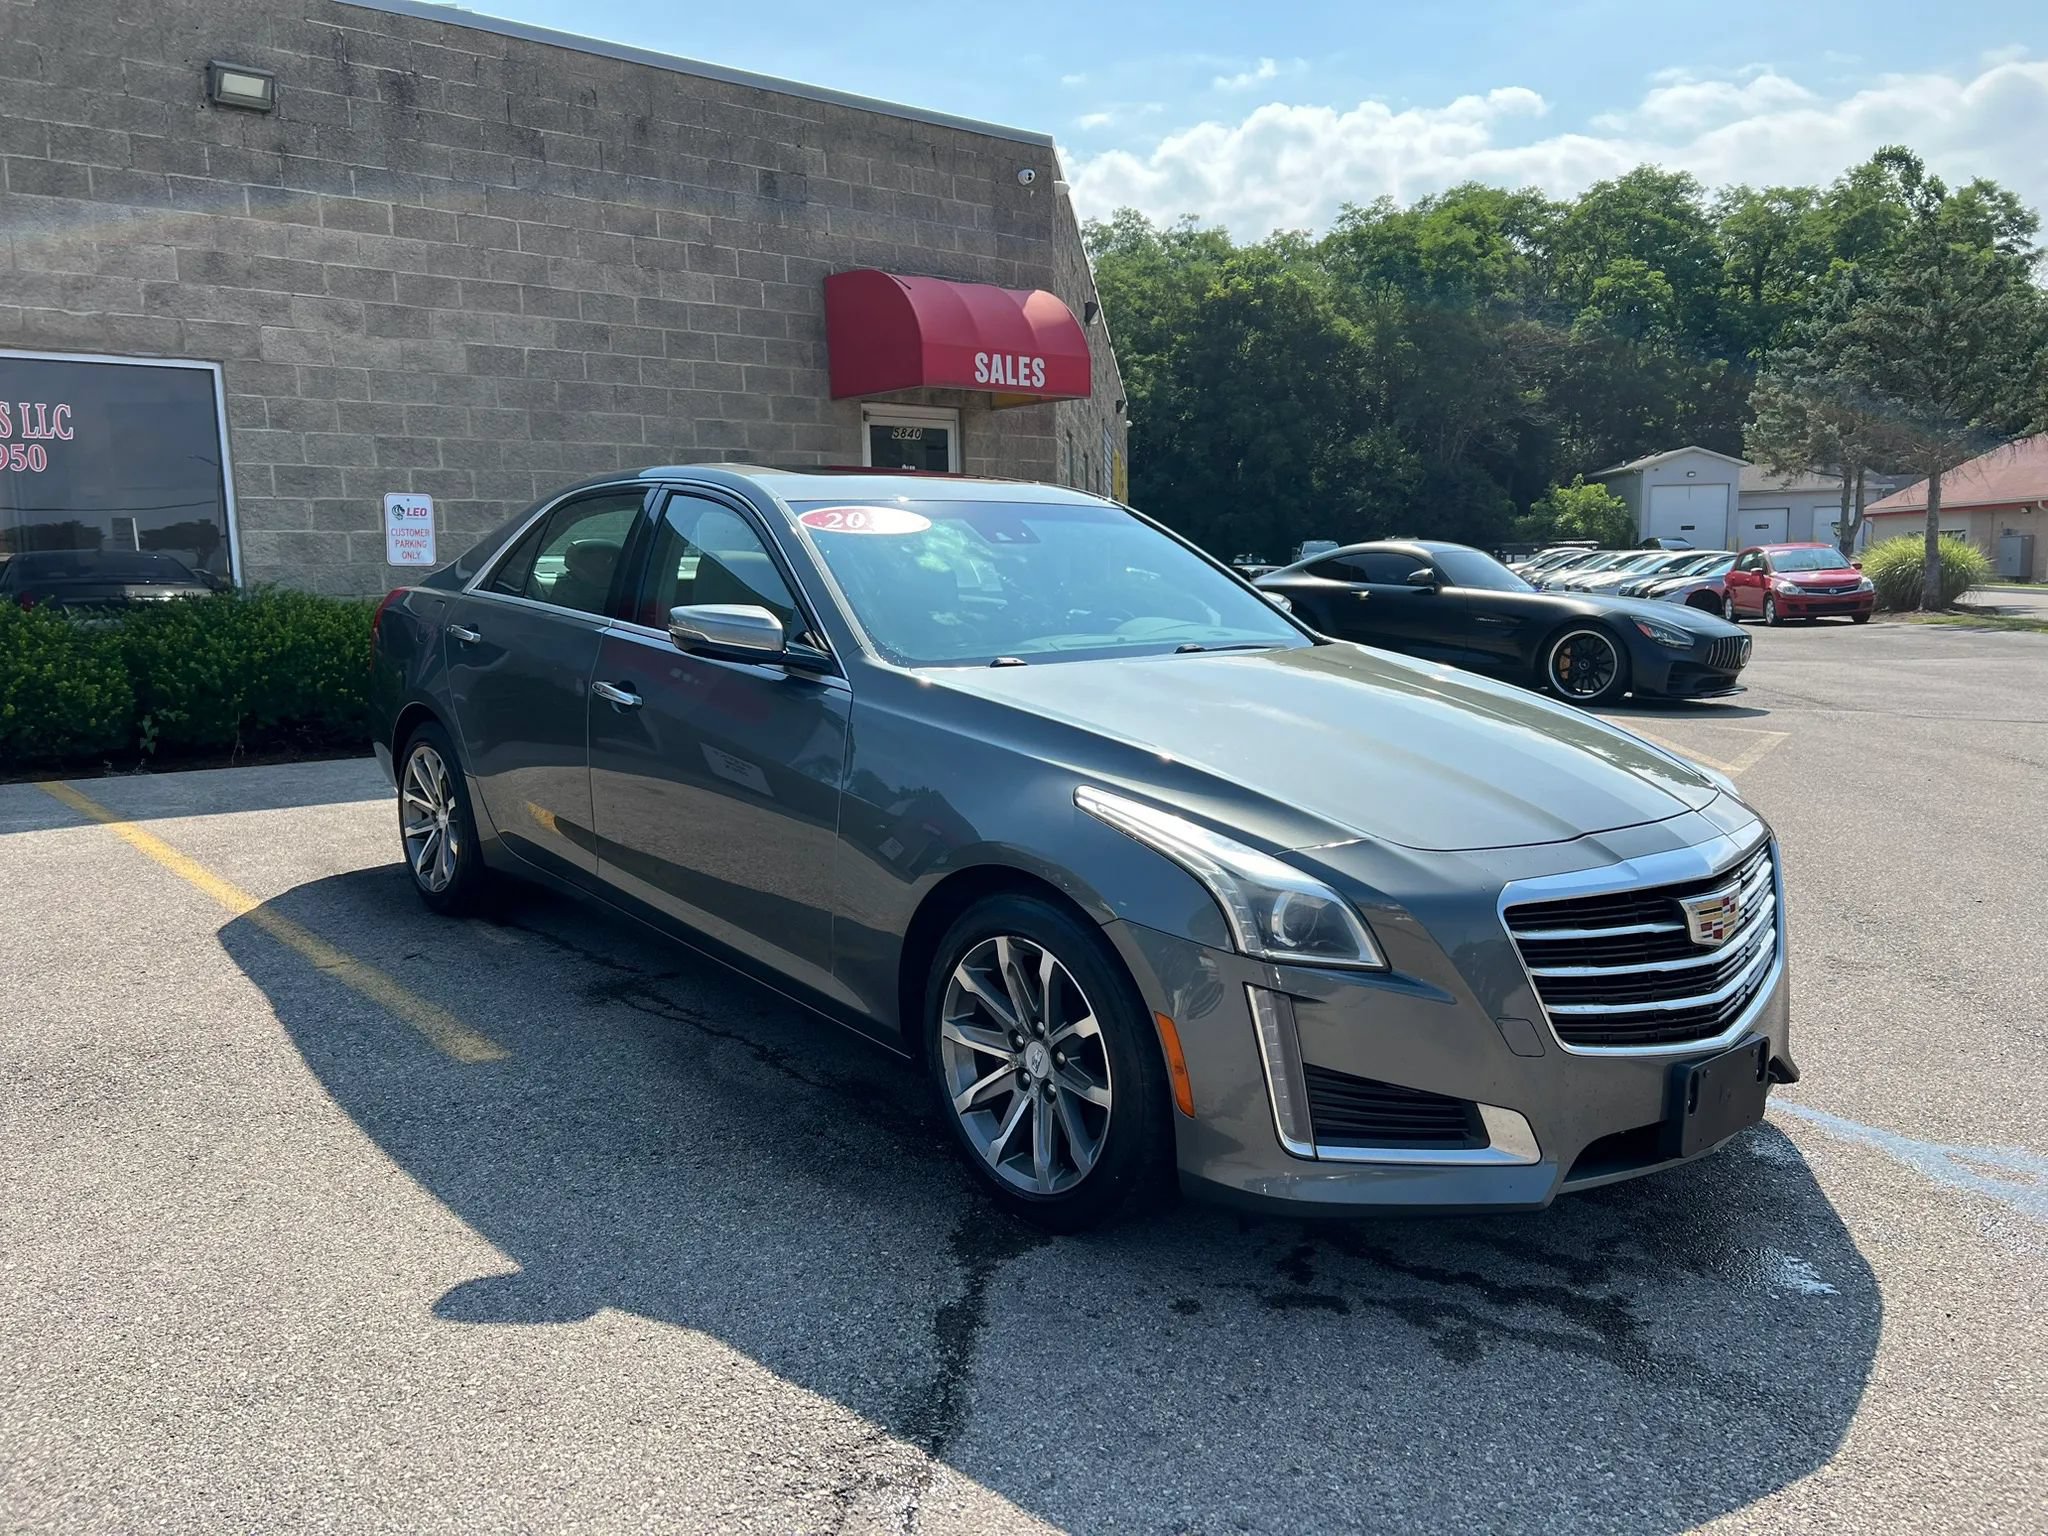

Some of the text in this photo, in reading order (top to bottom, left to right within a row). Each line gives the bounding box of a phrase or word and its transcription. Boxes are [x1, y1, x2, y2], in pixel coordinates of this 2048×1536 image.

[974, 351, 1046, 388] SALES
[18, 402, 74, 440] LLC
[892, 427, 922, 439] 5840
[406, 507, 428, 517] LEO
[390, 528, 431, 537] CUSTOMER
[395, 539, 427, 549] PARKING
[402, 550, 421, 560] ONLY
